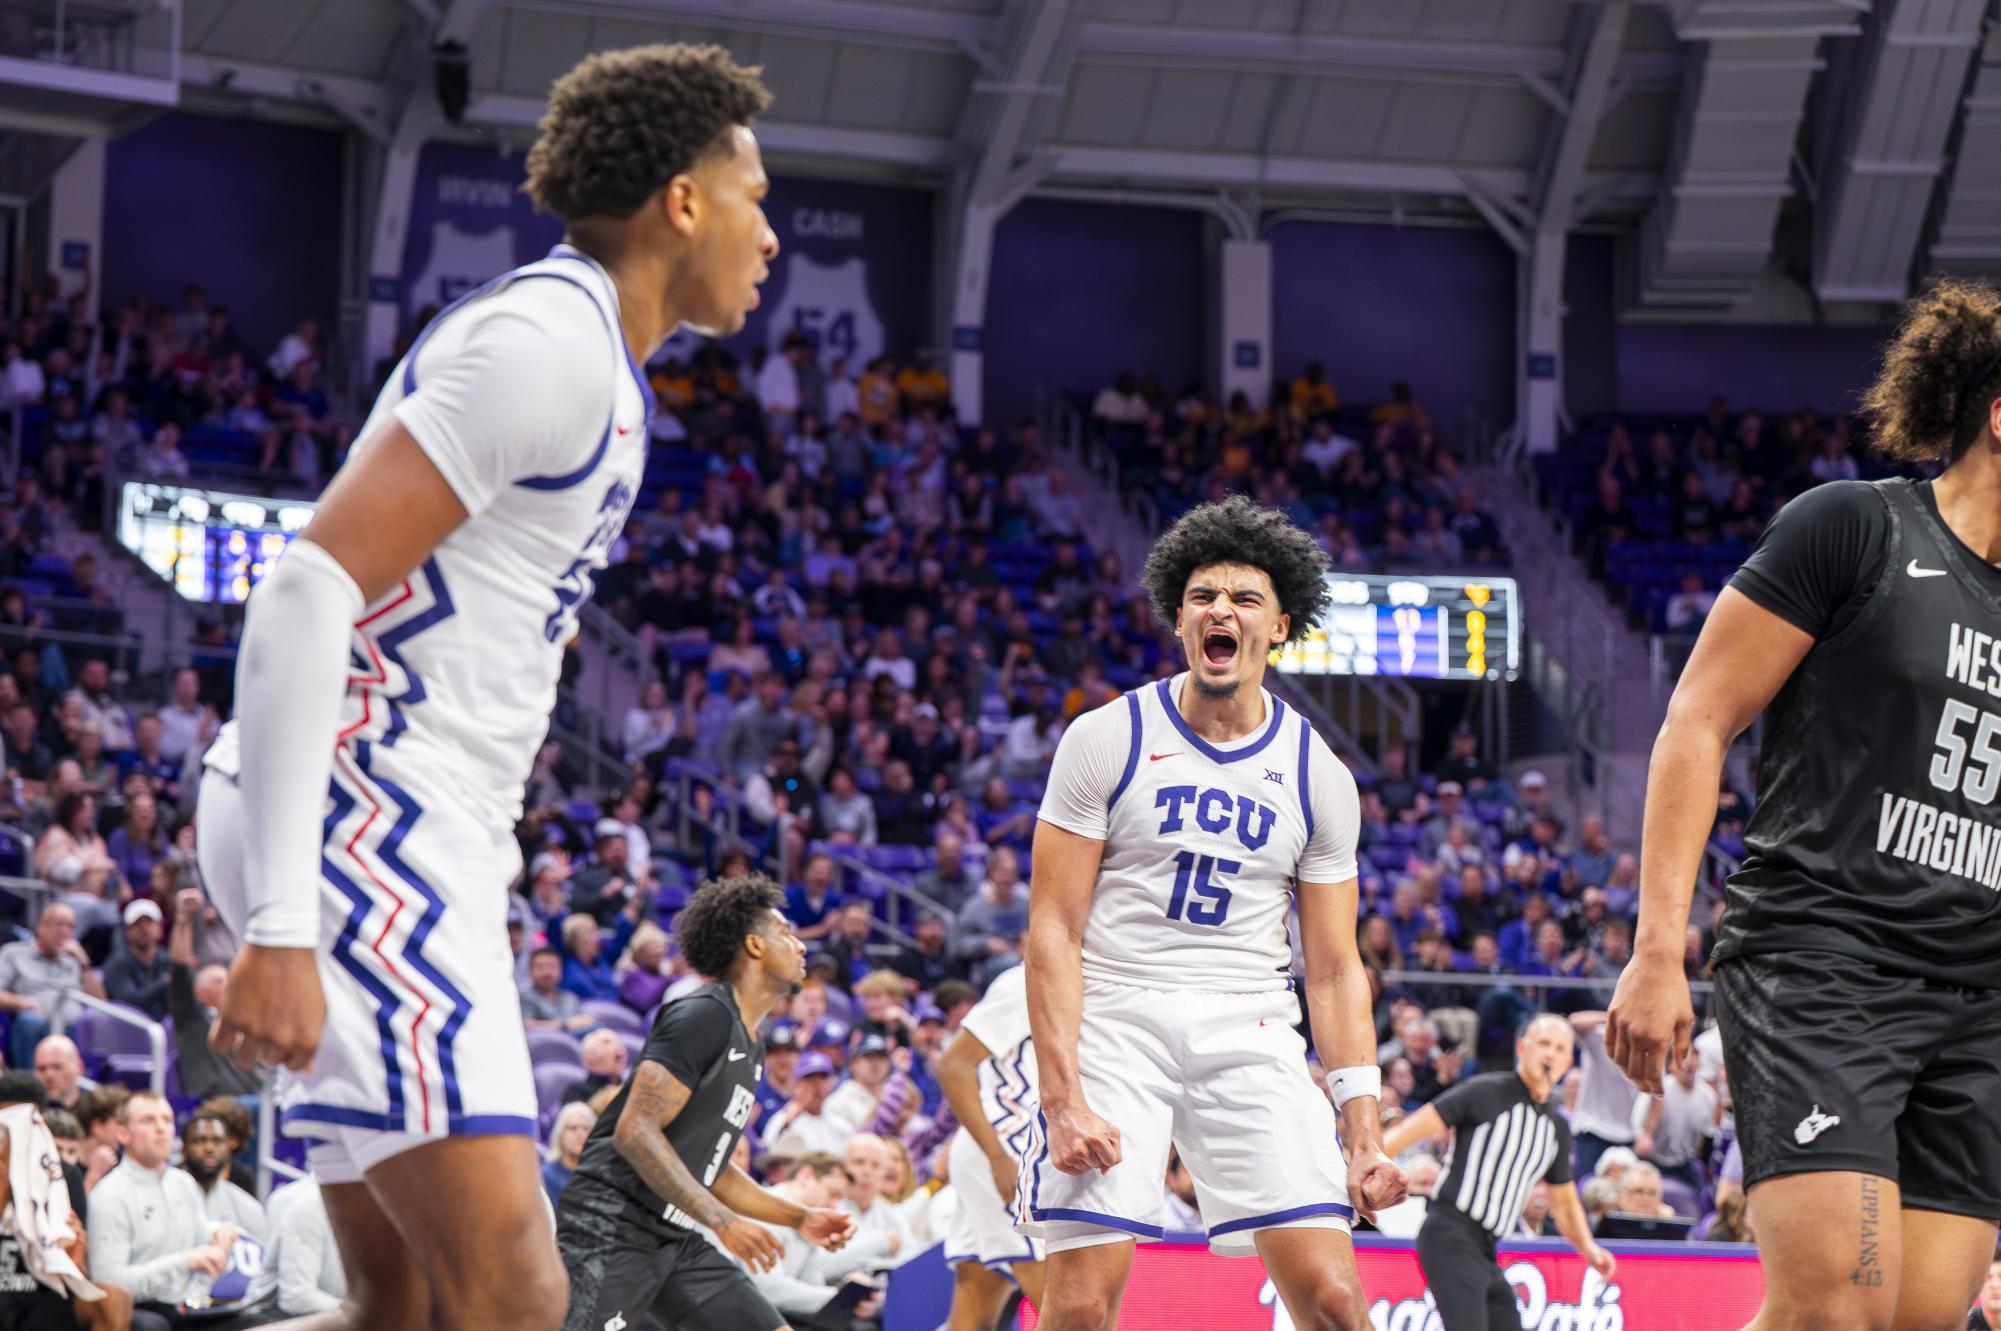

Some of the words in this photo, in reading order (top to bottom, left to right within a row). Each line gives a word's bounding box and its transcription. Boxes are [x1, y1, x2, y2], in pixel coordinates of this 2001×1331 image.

[793, 207, 863, 239] CASH
[1263, 768, 1285, 785] XII
[1928, 697, 2001, 806] 55
[1154, 785, 1277, 852] TCU
[1166, 850, 1243, 927] 15
